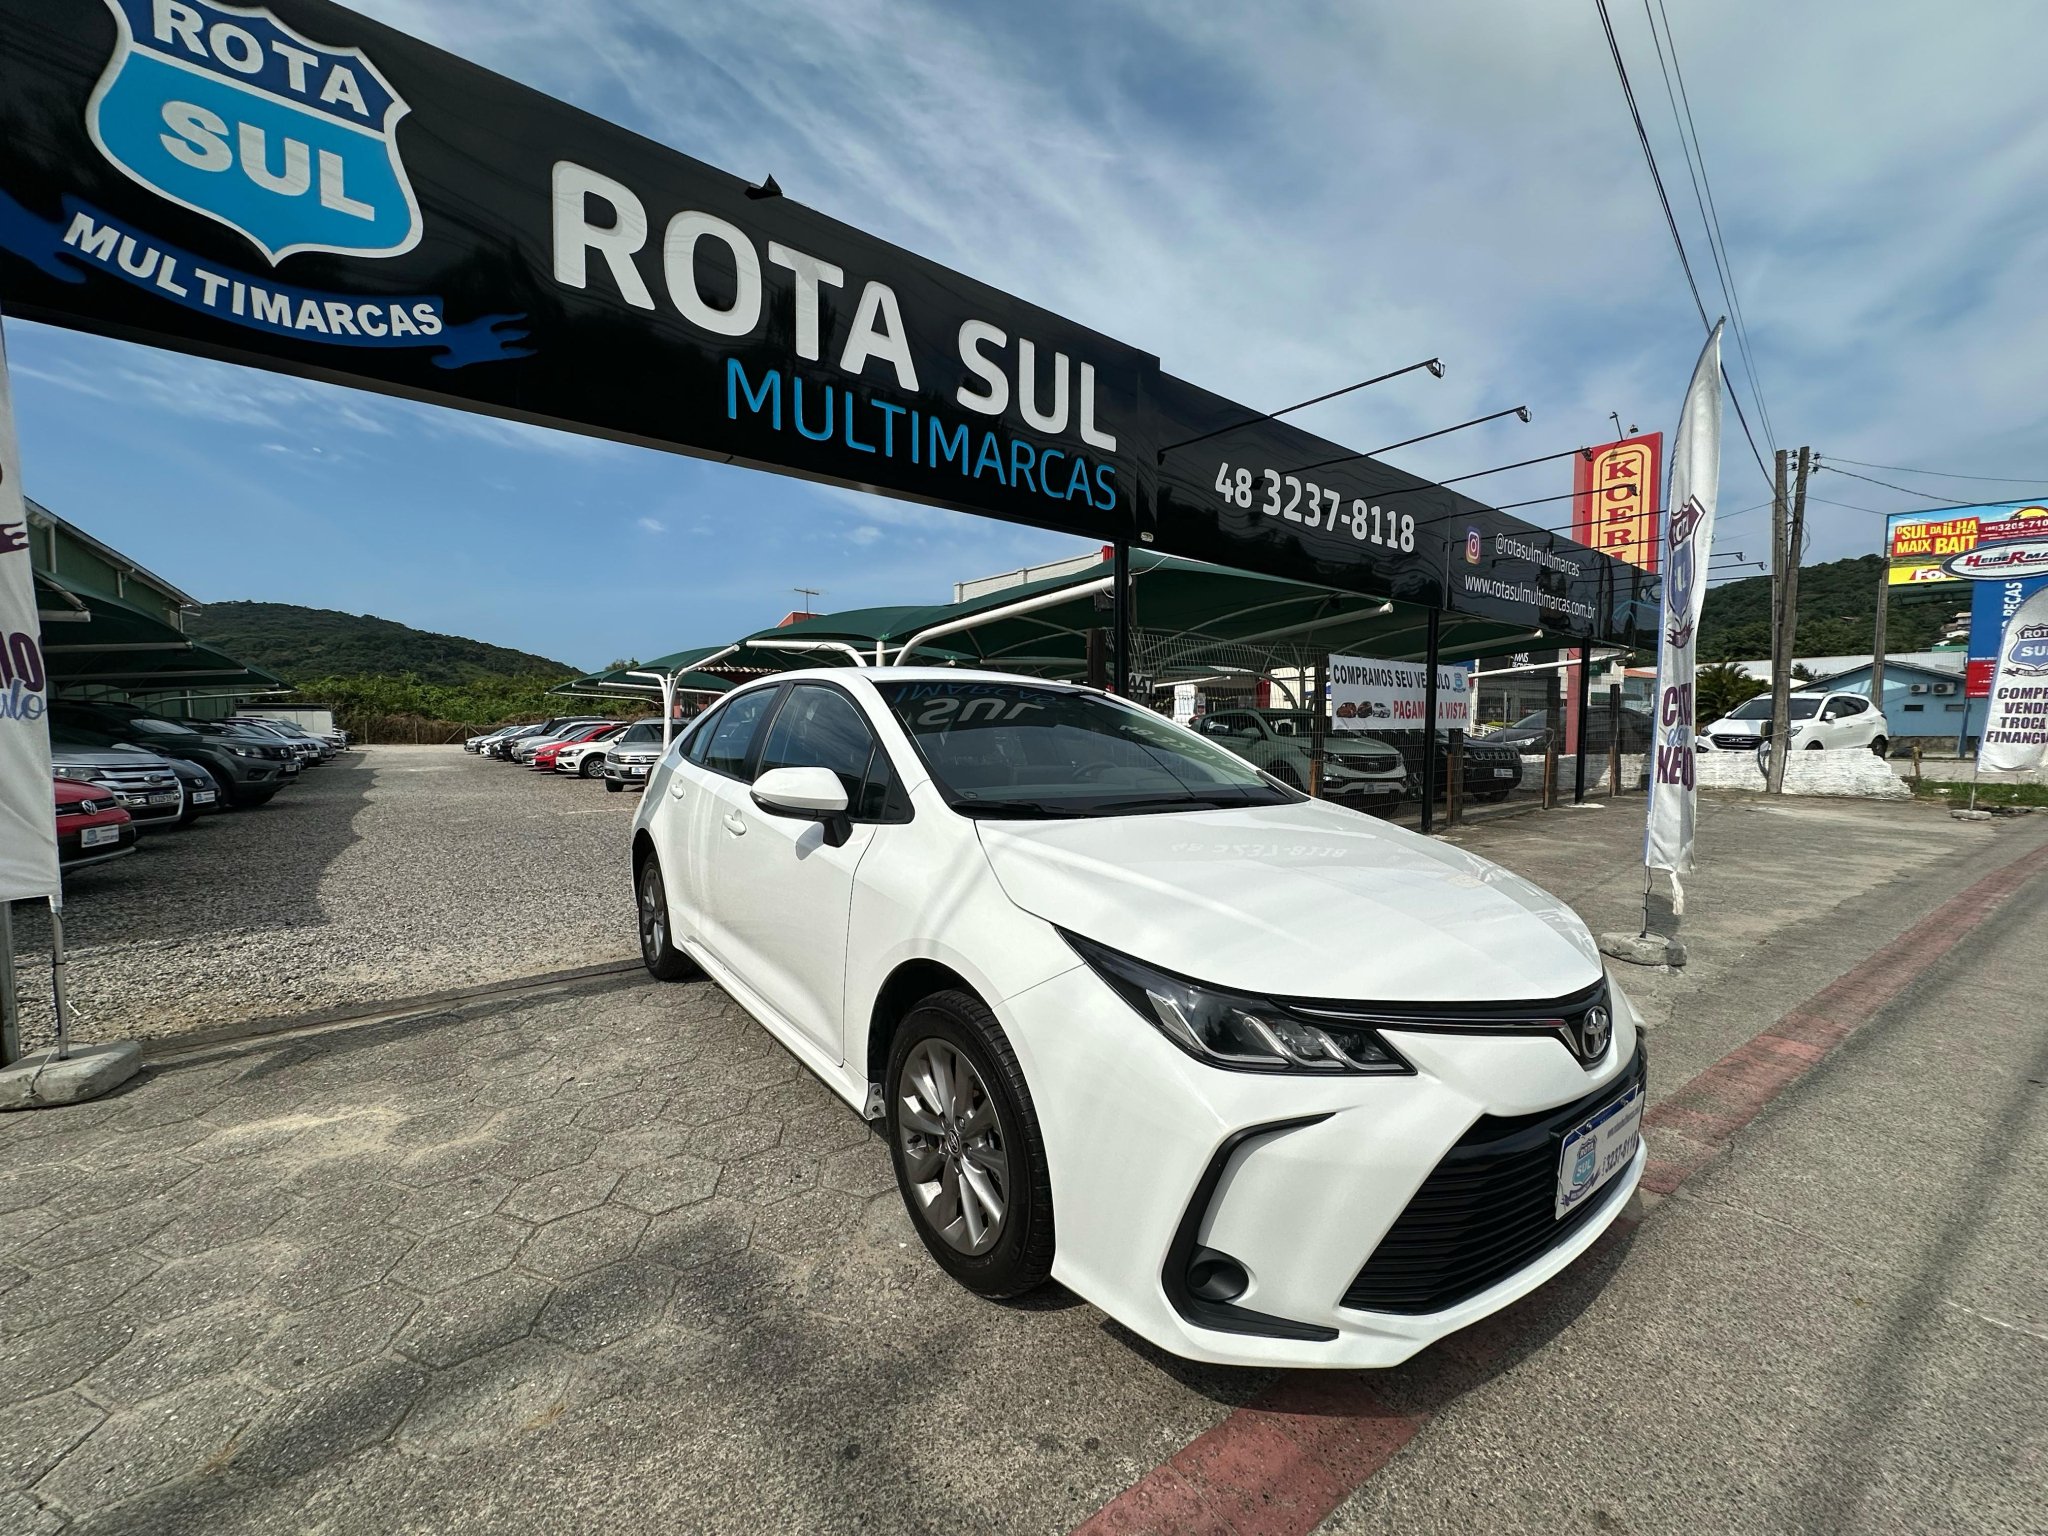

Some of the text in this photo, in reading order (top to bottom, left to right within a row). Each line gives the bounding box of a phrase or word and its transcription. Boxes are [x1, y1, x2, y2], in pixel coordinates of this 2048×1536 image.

[153, 0, 370, 117] ROTA
[159, 99, 375, 222] SUL
[63, 210, 444, 338] MULTIMARCAS
[551, 159, 1117, 453] ROTA SUL
[726, 357, 1117, 511] MULTIMARCAS
[1215, 462, 1415, 553] 48 3237-8118
[1495, 532, 1580, 577] @rotasulmultimarcas
[1896, 534, 1979, 555] MAIX BAIT
[1901, 525, 1930, 540] SUL
[1929, 526, 1942, 535] DA
[1464, 574, 1596, 620] www.rotasulmultimarcas.com.br
[2020, 645, 2048, 657] SU
[1332, 664, 1394, 688] COMPRAMOS
[1395, 670, 1413, 689] SEU
[1393, 700, 1425, 720] PAGAM
[1445, 702, 1468, 720] VISTA
[1999, 716, 2047, 730] TROCA
[1985, 730, 2048, 745] FINANCI
